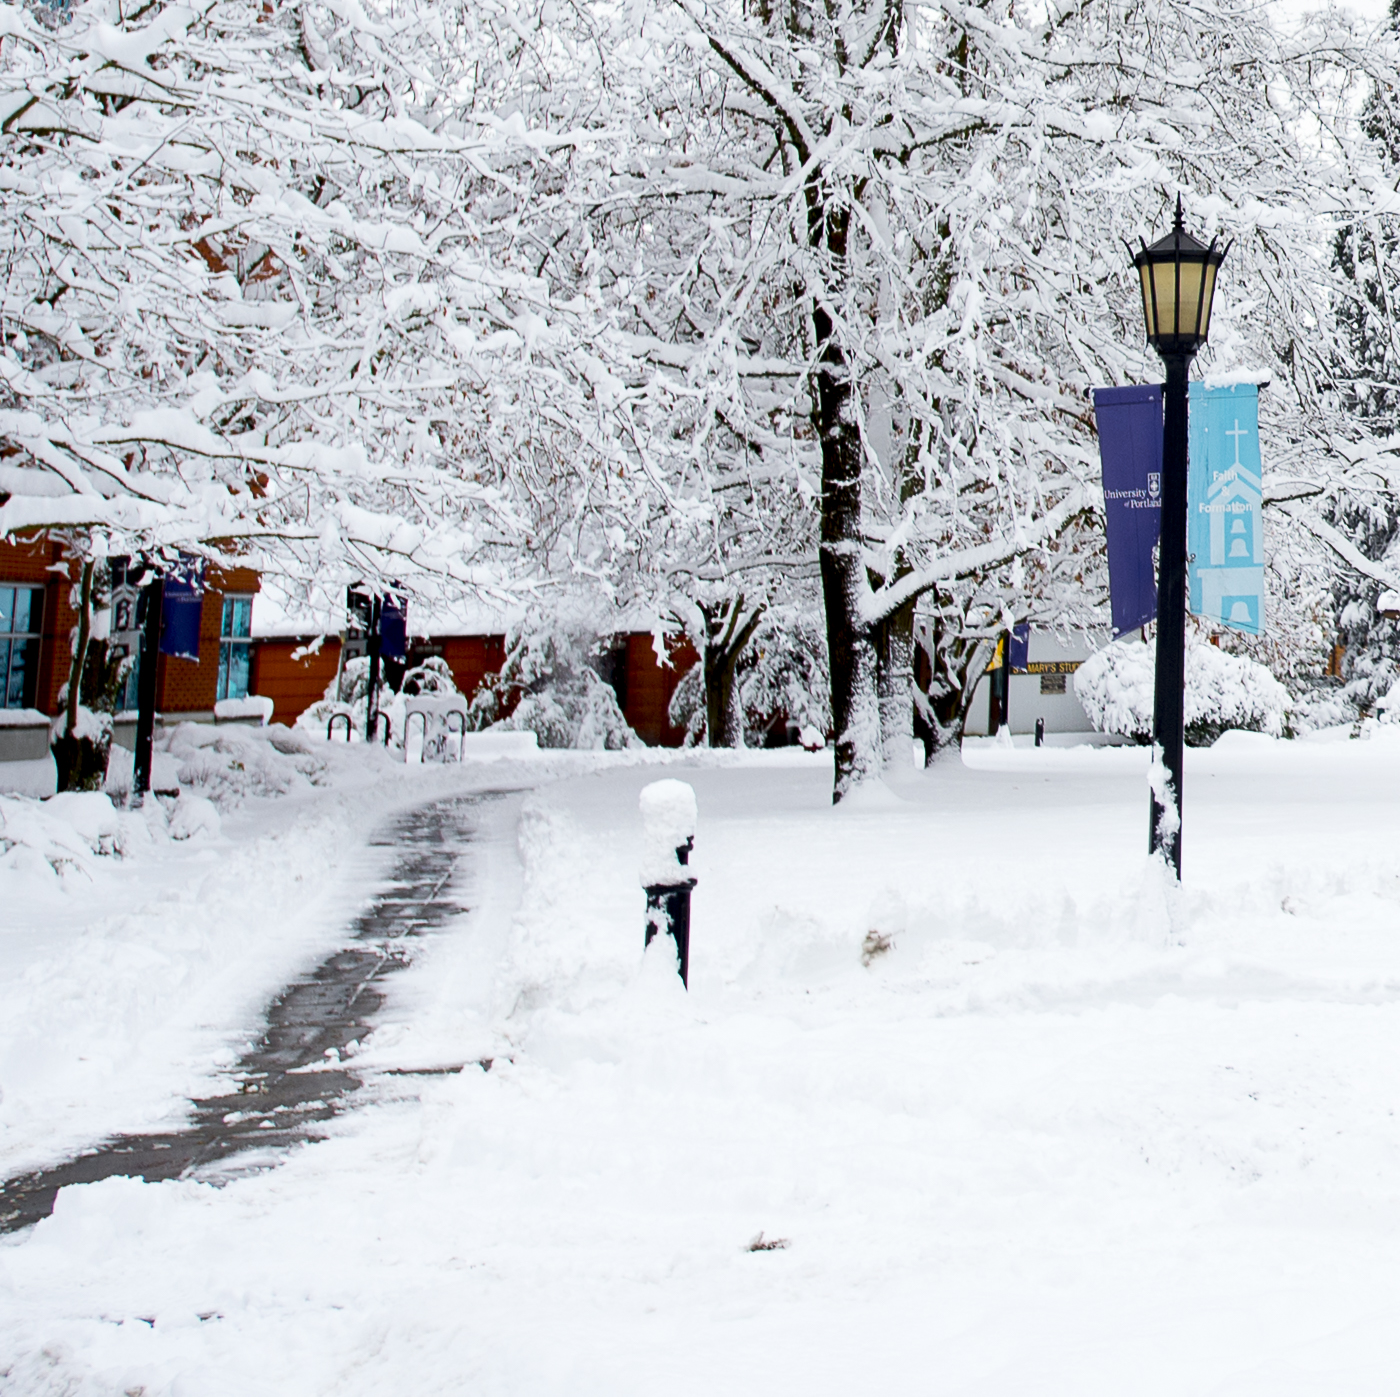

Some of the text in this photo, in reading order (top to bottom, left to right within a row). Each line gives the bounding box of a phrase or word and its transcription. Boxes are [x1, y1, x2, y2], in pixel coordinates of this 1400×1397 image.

[1213, 469, 1238, 481] Faith
[1104, 487, 1147, 500] University
[1221, 486, 1230, 497] &
[1130, 497, 1162, 509] Portland
[1198, 501, 1253, 514] Formation
